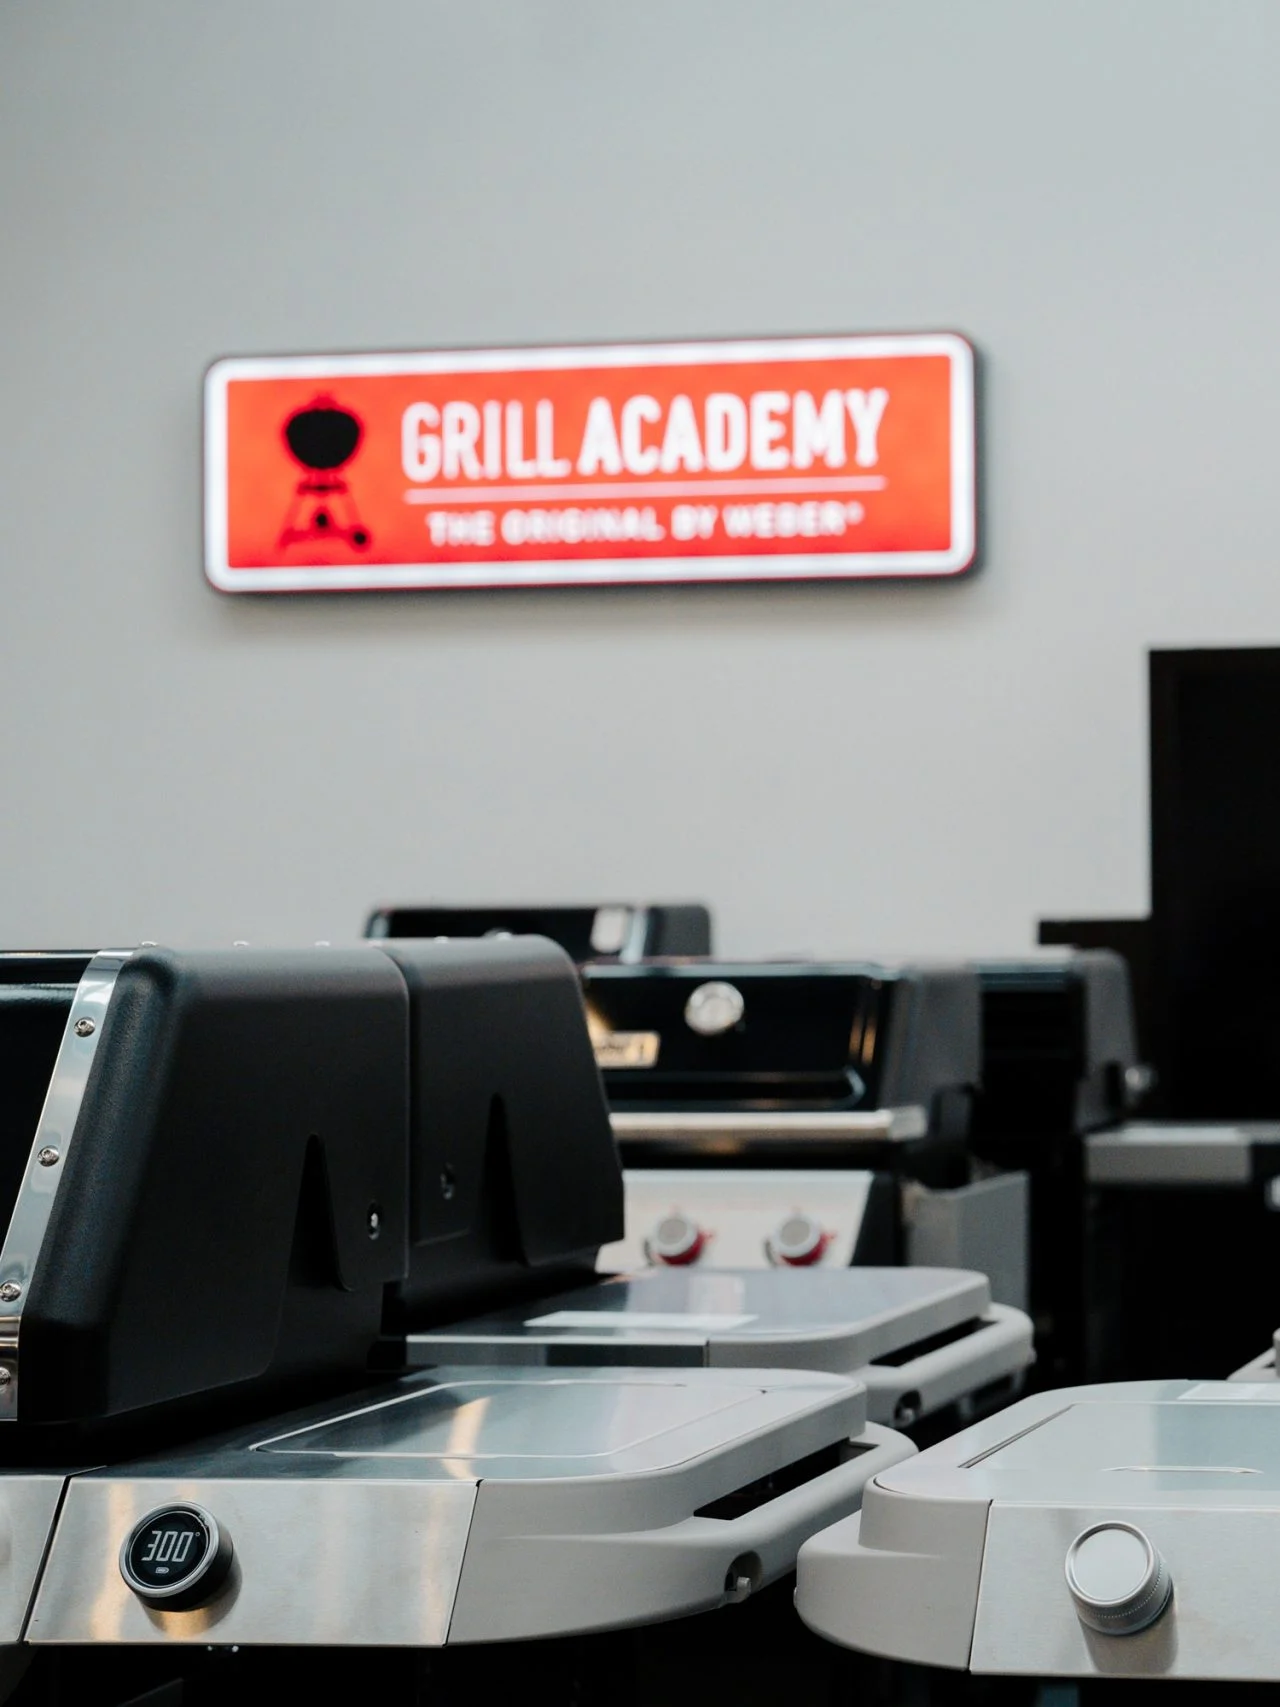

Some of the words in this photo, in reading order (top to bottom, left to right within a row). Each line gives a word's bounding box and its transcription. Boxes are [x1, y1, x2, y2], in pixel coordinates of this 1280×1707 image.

[401, 399, 572, 483] GRILL
[576, 386, 889, 476] ACADEMY
[425, 510, 496, 547] THE
[501, 506, 667, 545] ORIGINAL
[671, 504, 718, 541] BY
